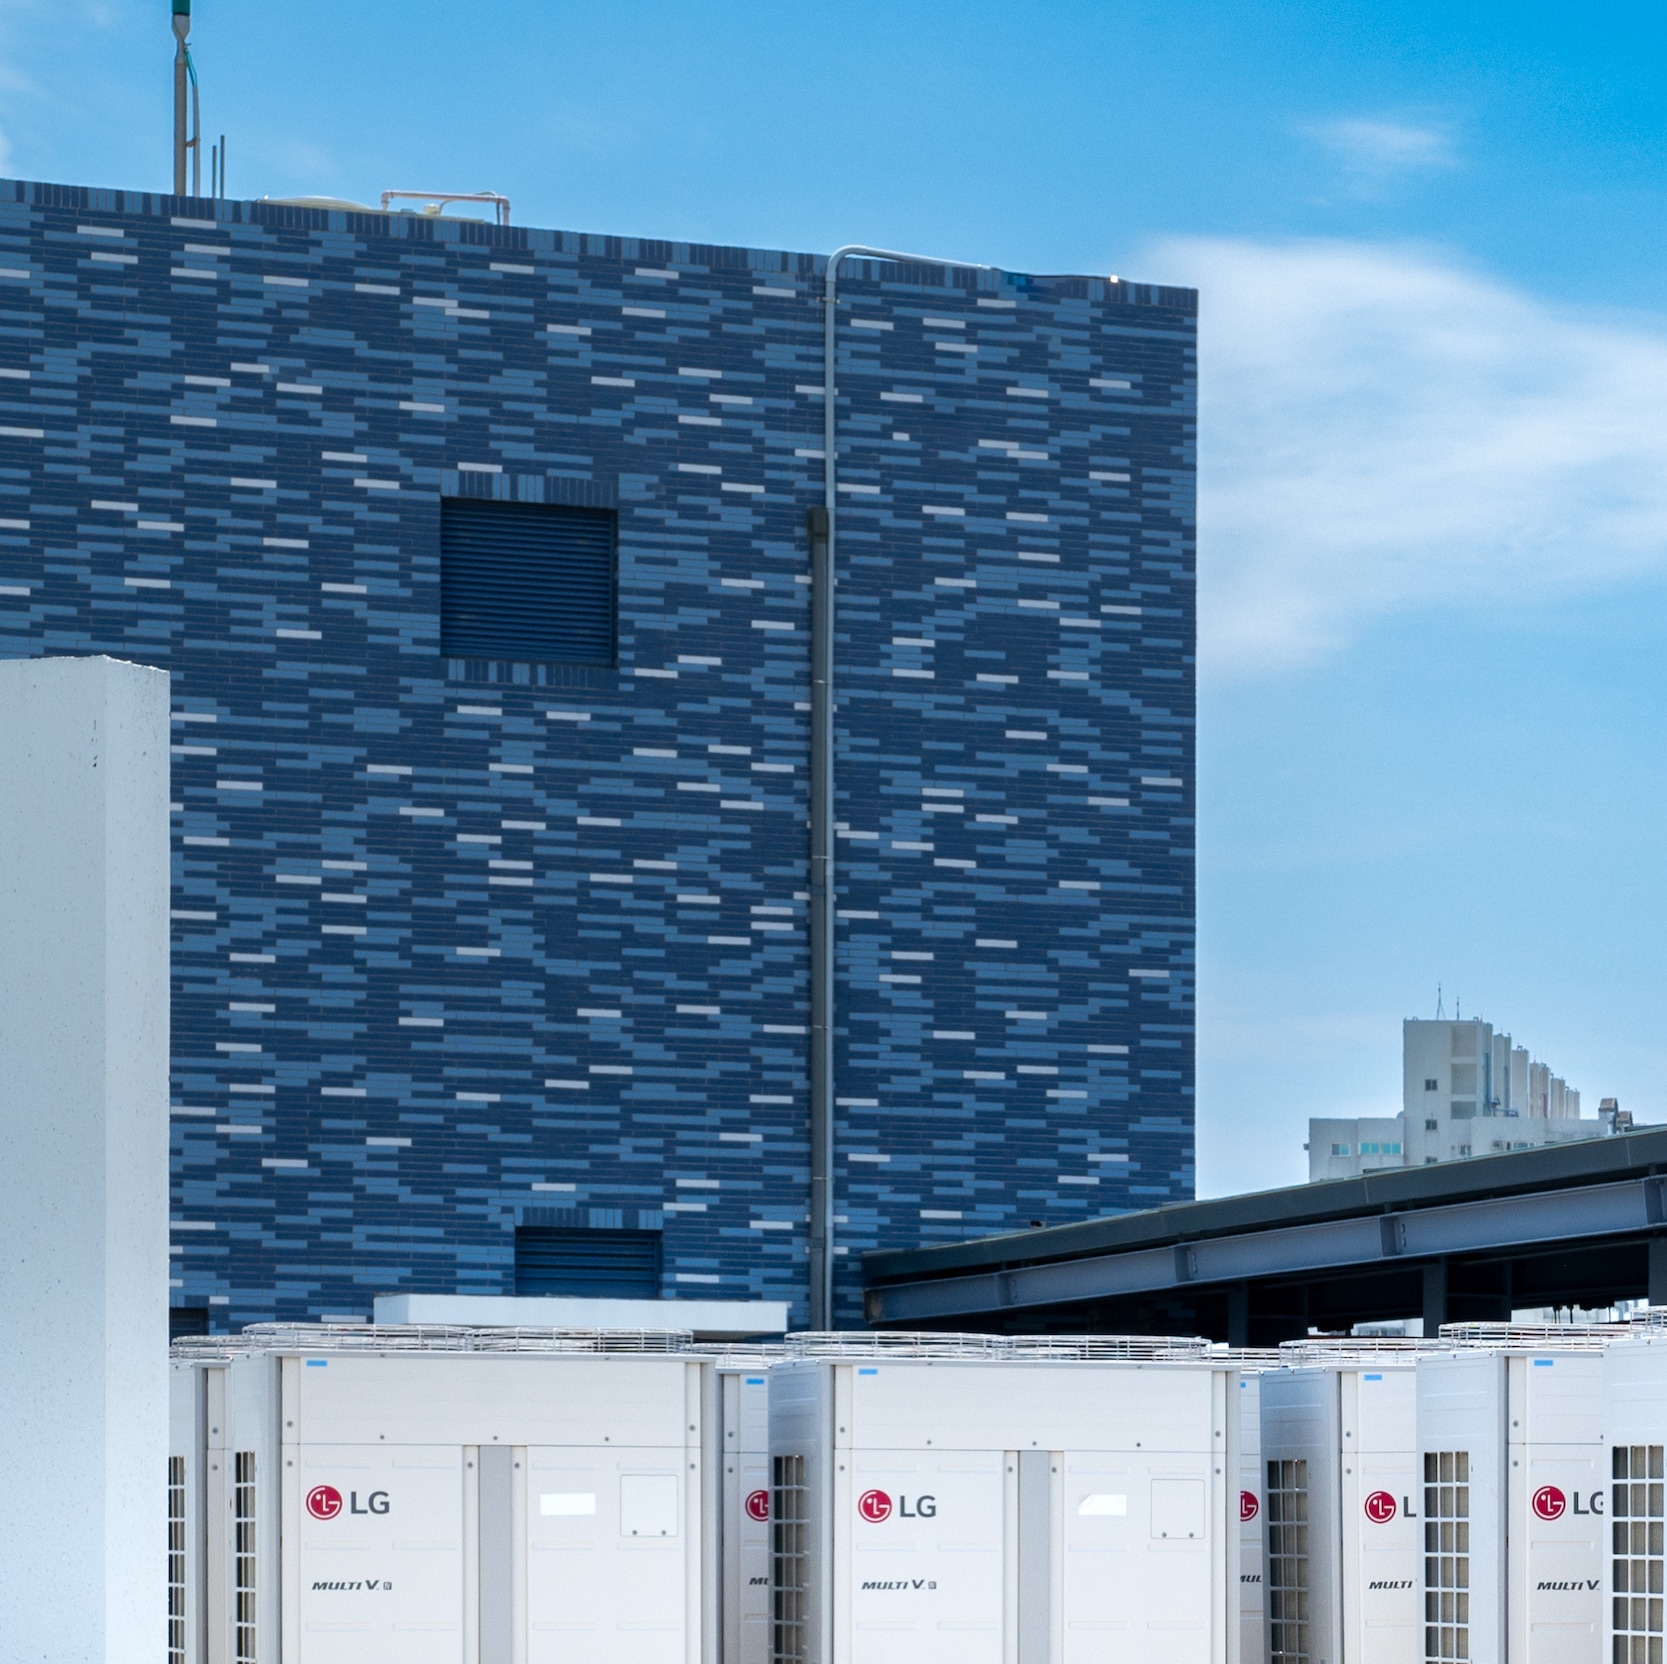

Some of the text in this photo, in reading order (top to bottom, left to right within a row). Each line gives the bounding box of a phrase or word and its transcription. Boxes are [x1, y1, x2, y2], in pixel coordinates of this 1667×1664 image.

[350, 1490, 390, 1515] LG
[899, 1495, 937, 1518] LG
[1403, 1495, 1416, 1518] L
[1573, 1491, 1603, 1516] LG
[311, 1581, 362, 1591] MULTI
[861, 1581, 909, 1590] MULTI
[1368, 1580, 1413, 1590] MULTI
[1536, 1581, 1584, 1591] MULTI
